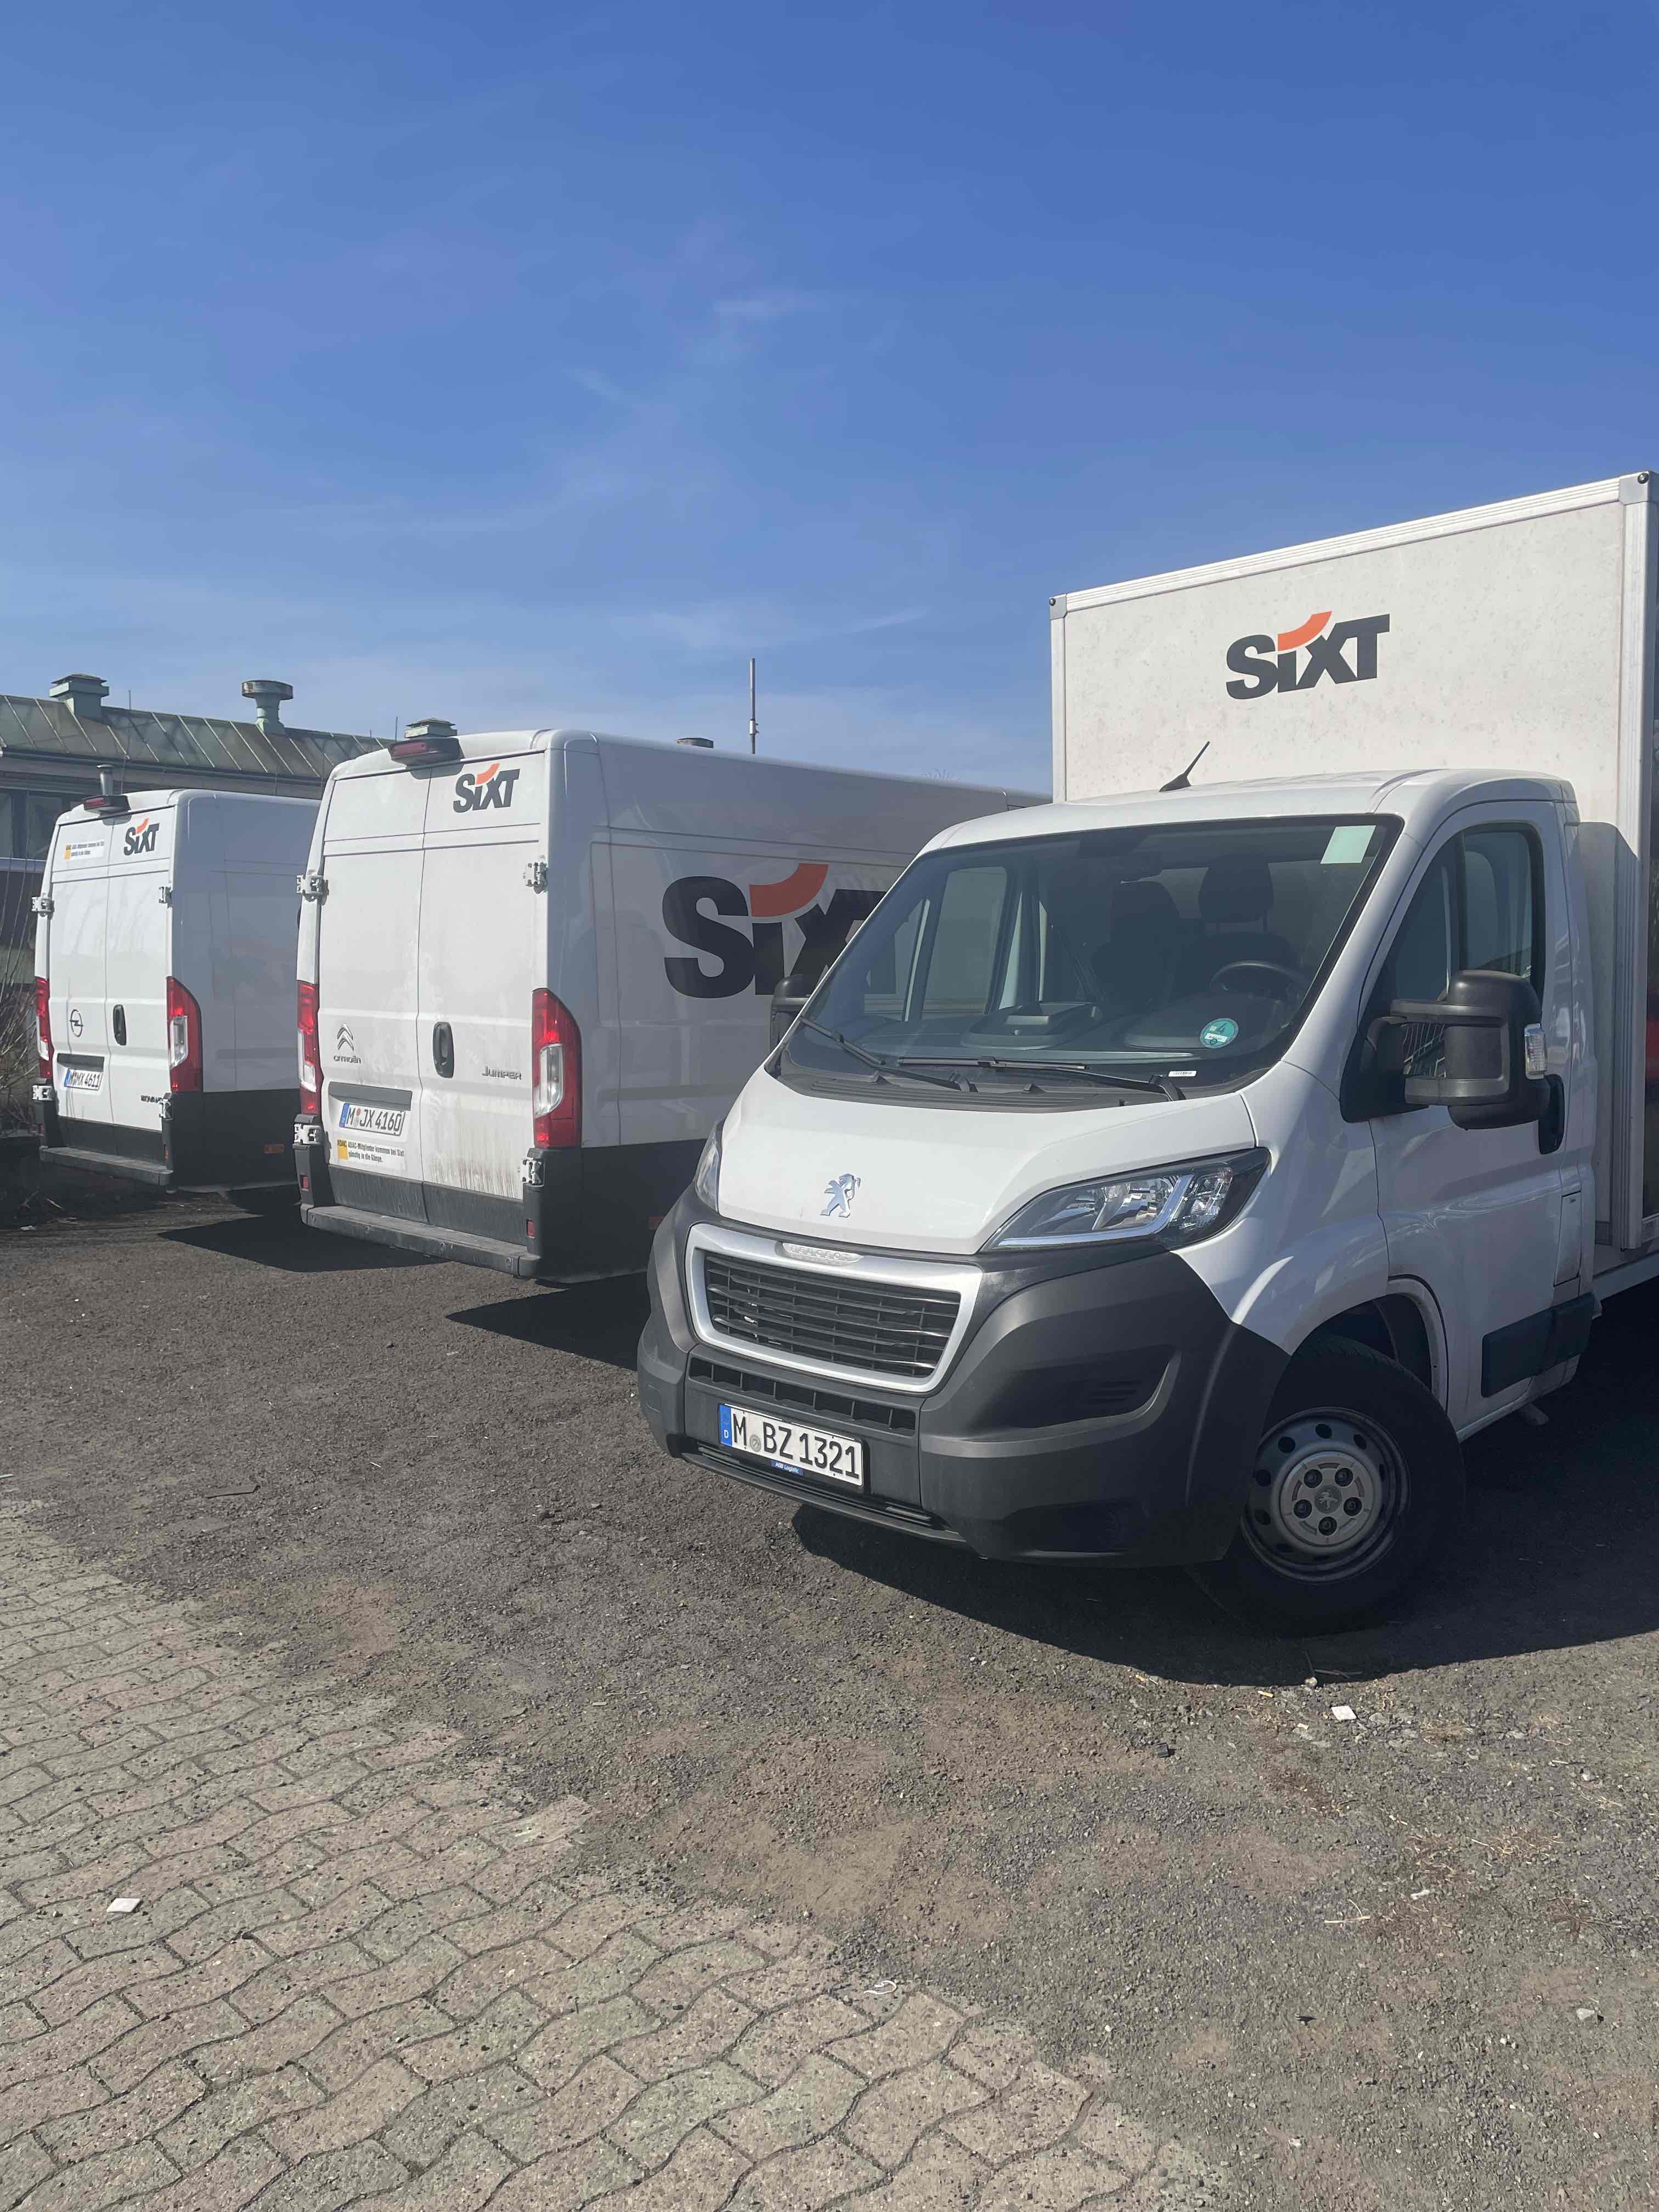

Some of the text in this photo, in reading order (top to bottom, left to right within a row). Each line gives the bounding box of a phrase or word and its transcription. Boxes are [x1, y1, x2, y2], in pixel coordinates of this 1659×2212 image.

[346, 1108, 402, 1131] M JX 4160
[789, 1245, 849, 1261] PEUGEOT
[724, 1429, 729, 1438] D
[733, 1413, 860, 1479] M BZ 1321
